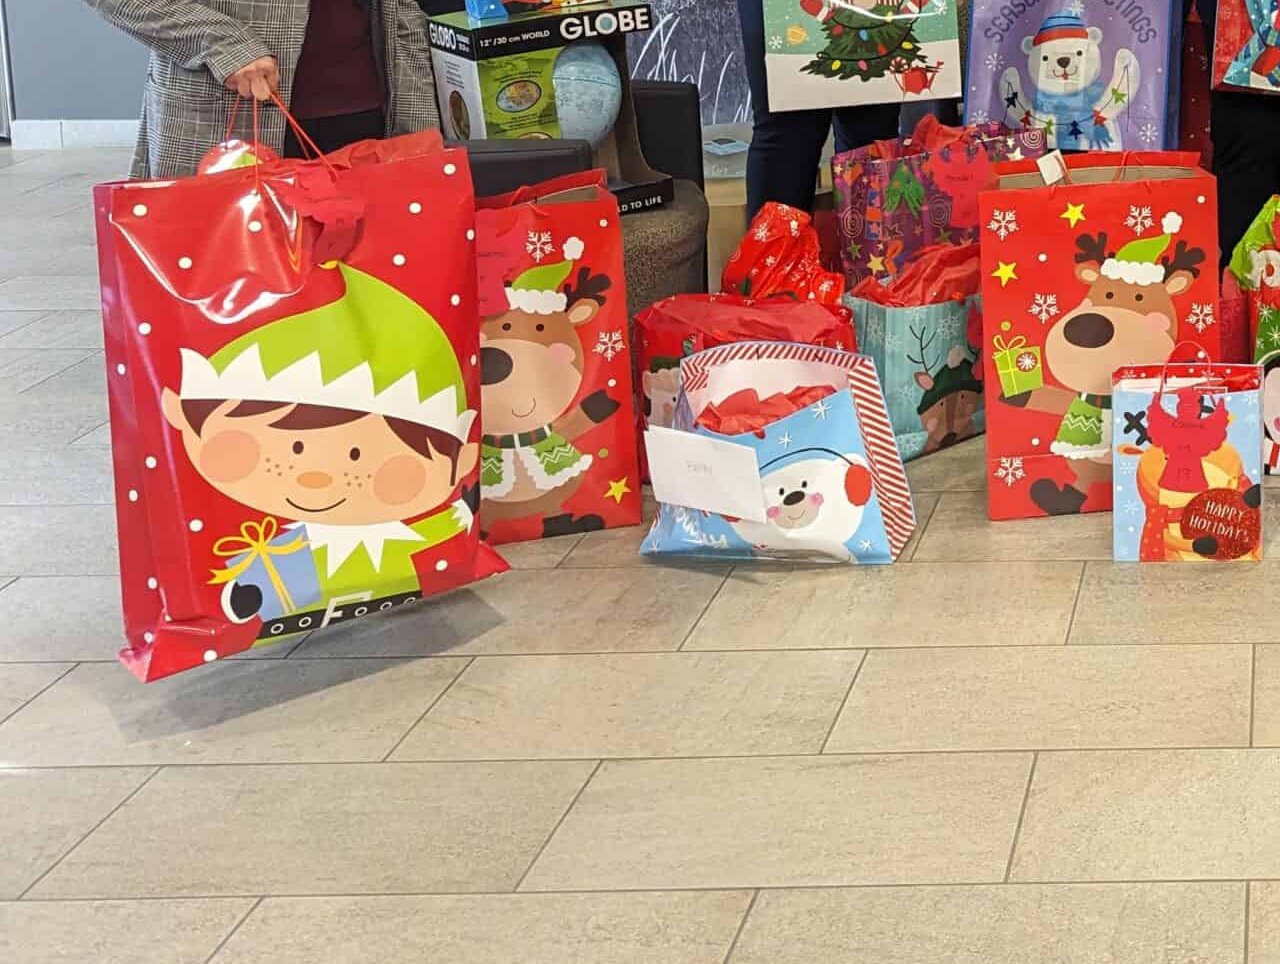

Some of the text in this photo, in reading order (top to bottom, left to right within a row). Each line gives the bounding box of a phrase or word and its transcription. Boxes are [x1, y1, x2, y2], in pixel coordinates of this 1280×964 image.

[429, 22, 457, 50] GLOBO
[521, 29, 550, 40] WORLD
[560, 7, 650, 40] GLOBE
[630, 200, 642, 209] TO
[644, 195, 662, 206] LIFE
[1205, 499, 1246, 522] HAPPY
[1188, 513, 1249, 543] HOLIDAYS
